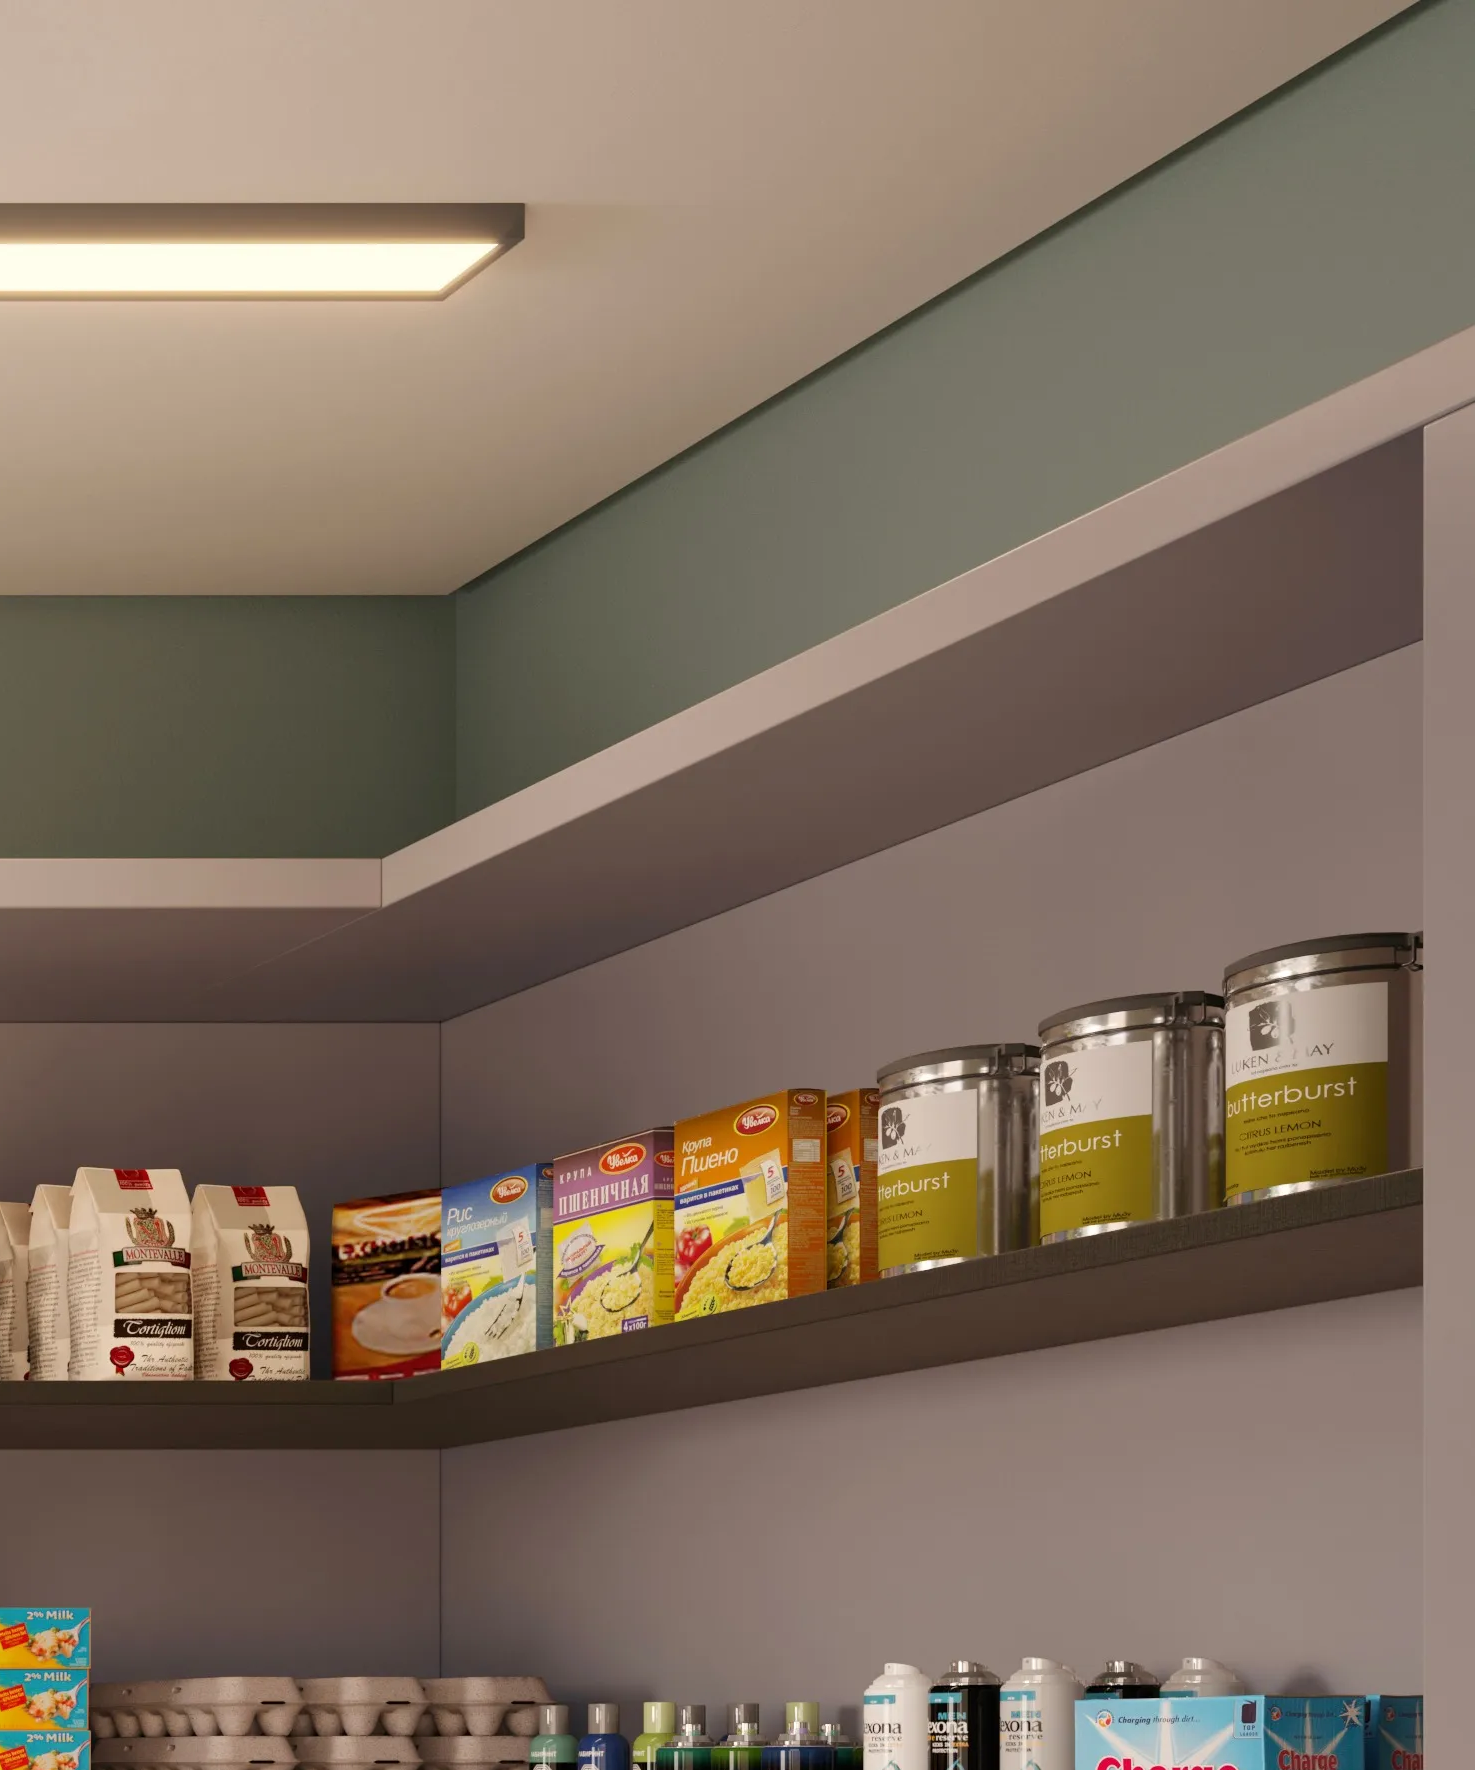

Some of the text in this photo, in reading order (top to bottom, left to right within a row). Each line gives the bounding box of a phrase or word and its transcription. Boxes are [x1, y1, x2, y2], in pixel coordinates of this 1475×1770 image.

[1227, 1076, 1357, 1118] butterburst
[742, 1114, 770, 1130] Увелка
[1275, 1120, 1321, 1136] LEMON
[683, 1137, 712, 1155] Крупа
[681, 1148, 738, 1176] Пшено
[560, 1166, 592, 1184] КРУПА
[768, 1167, 773, 1178] 5
[497, 1183, 521, 1198] Увелка
[559, 1174, 649, 1215] ПШЕНИЧНАЯ
[680, 1194, 702, 1204] варится
[709, 1185, 739, 1198] пакетиках
[770, 1184, 781, 1194] 100
[447, 1206, 473, 1225] Рис
[126, 1248, 184, 1262] MONTEVALLE
[123, 1321, 186, 1338] Tortiglioni
[27, 1611, 74, 1620] 2% Milk
[938, 1712, 966, 1720] MEN
[1118, 1715, 1150, 1726] Charging
[1153, 1715, 1178, 1725] through
